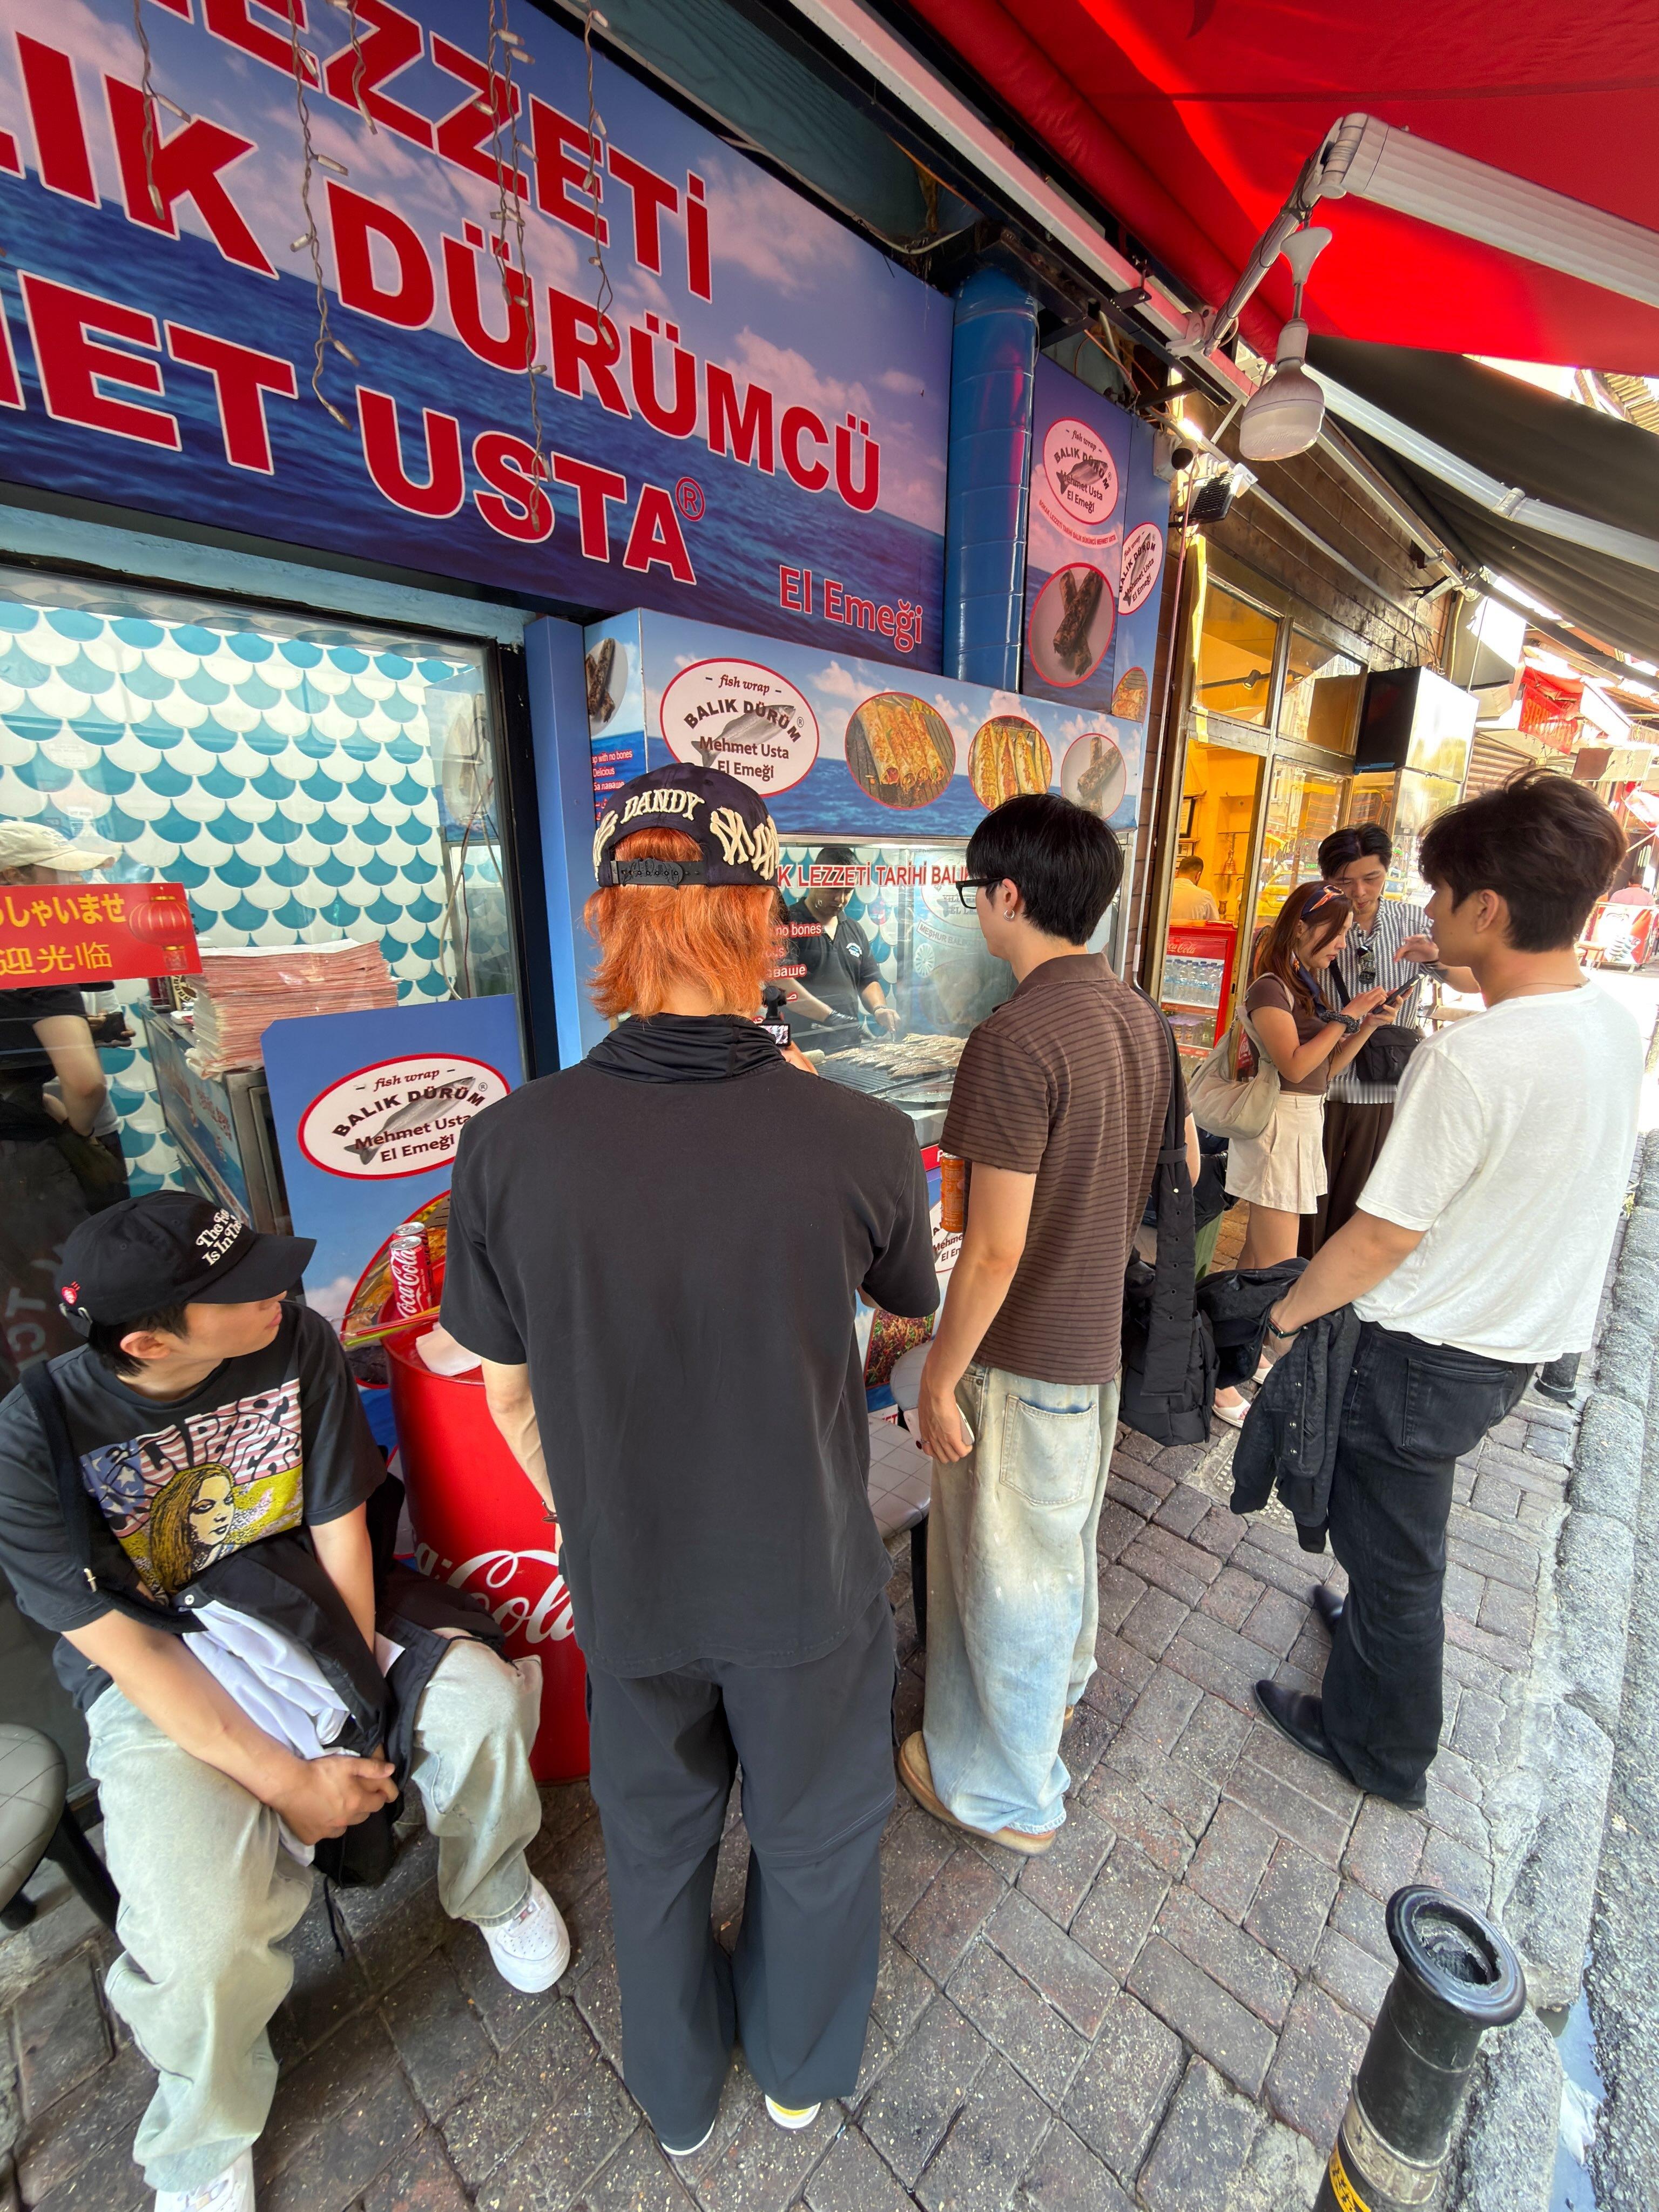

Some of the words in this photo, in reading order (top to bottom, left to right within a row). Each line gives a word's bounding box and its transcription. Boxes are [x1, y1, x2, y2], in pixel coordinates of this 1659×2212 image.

[145, 0, 713, 304] EZZETİ
[324, 177, 881, 514] DÜRÜMCÜ
[1072, 430, 1083, 442] fish
[1083, 438, 1097, 452] wrap
[1054, 447, 1080, 463] BALIK
[356, 384, 698, 586] USTA
[1061, 469, 1088, 493] Mehmet
[1089, 484, 1103, 501] Usta
[1067, 490, 1073, 502] El
[1075, 496, 1095, 514] Emeği
[1144, 558, 1155, 573] Usta
[779, 564, 812, 614] El
[824, 578, 923, 652] Emeği
[718, 674, 740, 689] fish
[743, 681, 770, 696] wrap
[683, 699, 738, 729] BALIK
[743, 700, 801, 743] DÜRÜM
[616, 750, 633, 760] bones
[699, 736, 758, 756] Mehmet
[761, 744, 789, 759] Usta
[593, 767, 615, 777] Delicious
[718, 760, 729, 773] El
[734, 762, 774, 782] Emeği
[621, 788, 705, 824] DANDY
[798, 861, 871, 888] LEZZETİ
[876, 860, 927, 888] TARİHİ
[776, 926, 789, 936] no
[791, 923, 822, 936] bones
[919, 923, 947, 943] MEŞHUR
[769, 966, 806, 978] ваше
[373, 1075, 401, 1092] fish
[404, 1070, 440, 1084] wrap
[332, 1094, 401, 1137] BALIK
[408, 1086, 485, 1107] DÜRÜM
[355, 1123, 431, 1150] Mehmet
[435, 1115, 471, 1130] Usta
[380, 1149, 397, 1162] El
[402, 1134, 455, 1157] Emeği
[195, 1223, 224, 1247] The
[933, 1233, 964, 1252] Mehme
[942, 1251, 949, 1262] El
